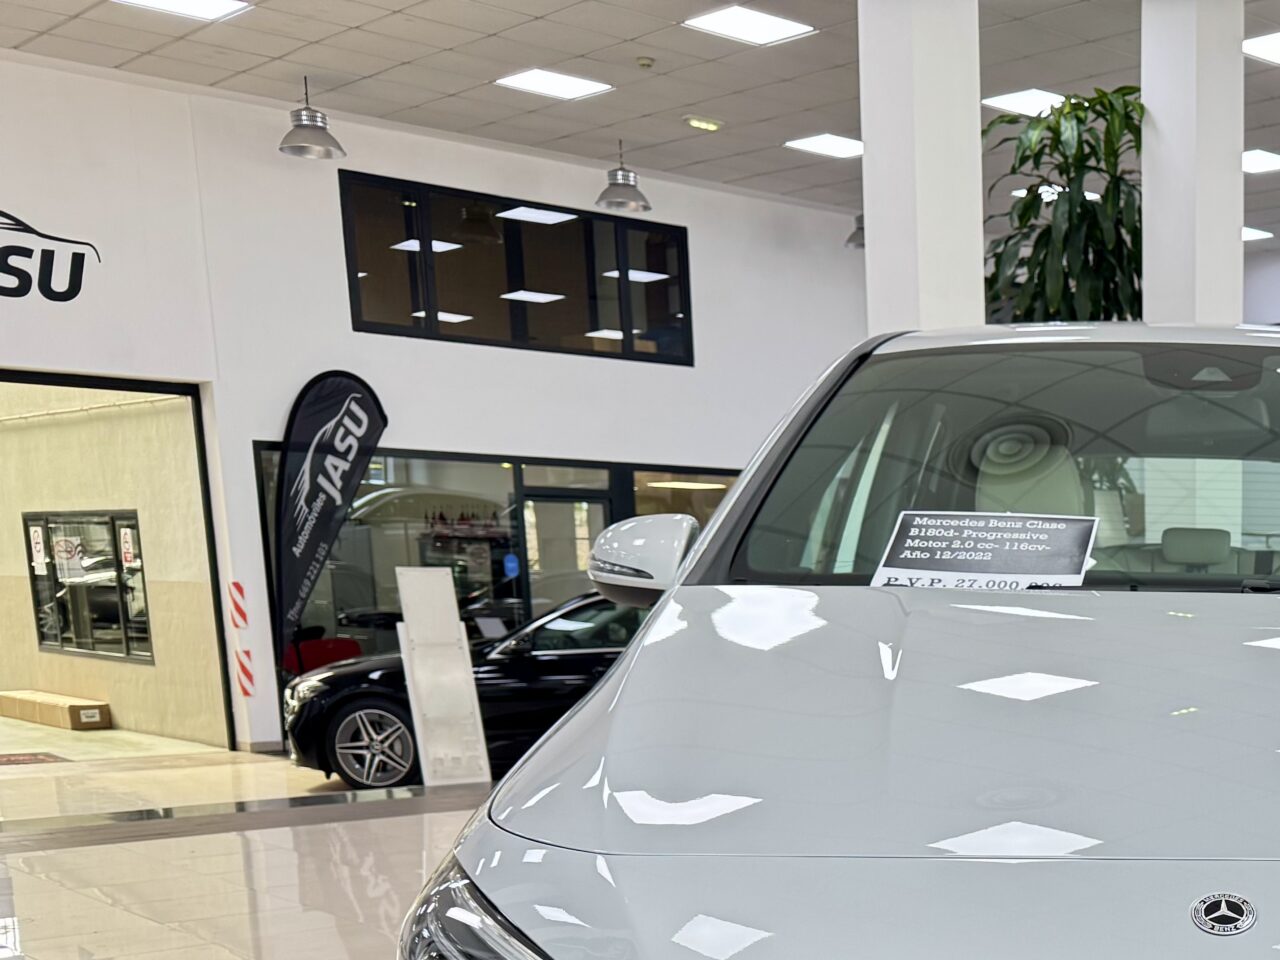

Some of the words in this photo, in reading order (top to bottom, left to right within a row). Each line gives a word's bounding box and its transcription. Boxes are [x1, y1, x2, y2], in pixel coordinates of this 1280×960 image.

[316, 400, 369, 506] JASU
[292, 491, 327, 558] Automóviles
[913, 516, 985, 527] Mercedes
[988, 519, 1023, 528] Benz
[1026, 520, 1067, 529] Clase
[908, 527, 959, 537] B180d-
[962, 529, 1049, 540] Progressive
[904, 539, 949, 548] Motor
[951, 540, 974, 549] 2.0
[977, 541, 1000, 549] cc-
[1004, 542, 1052, 551] 116cv-
[899, 550, 930, 559] Año
[935, 550, 992, 560] 12/2022
